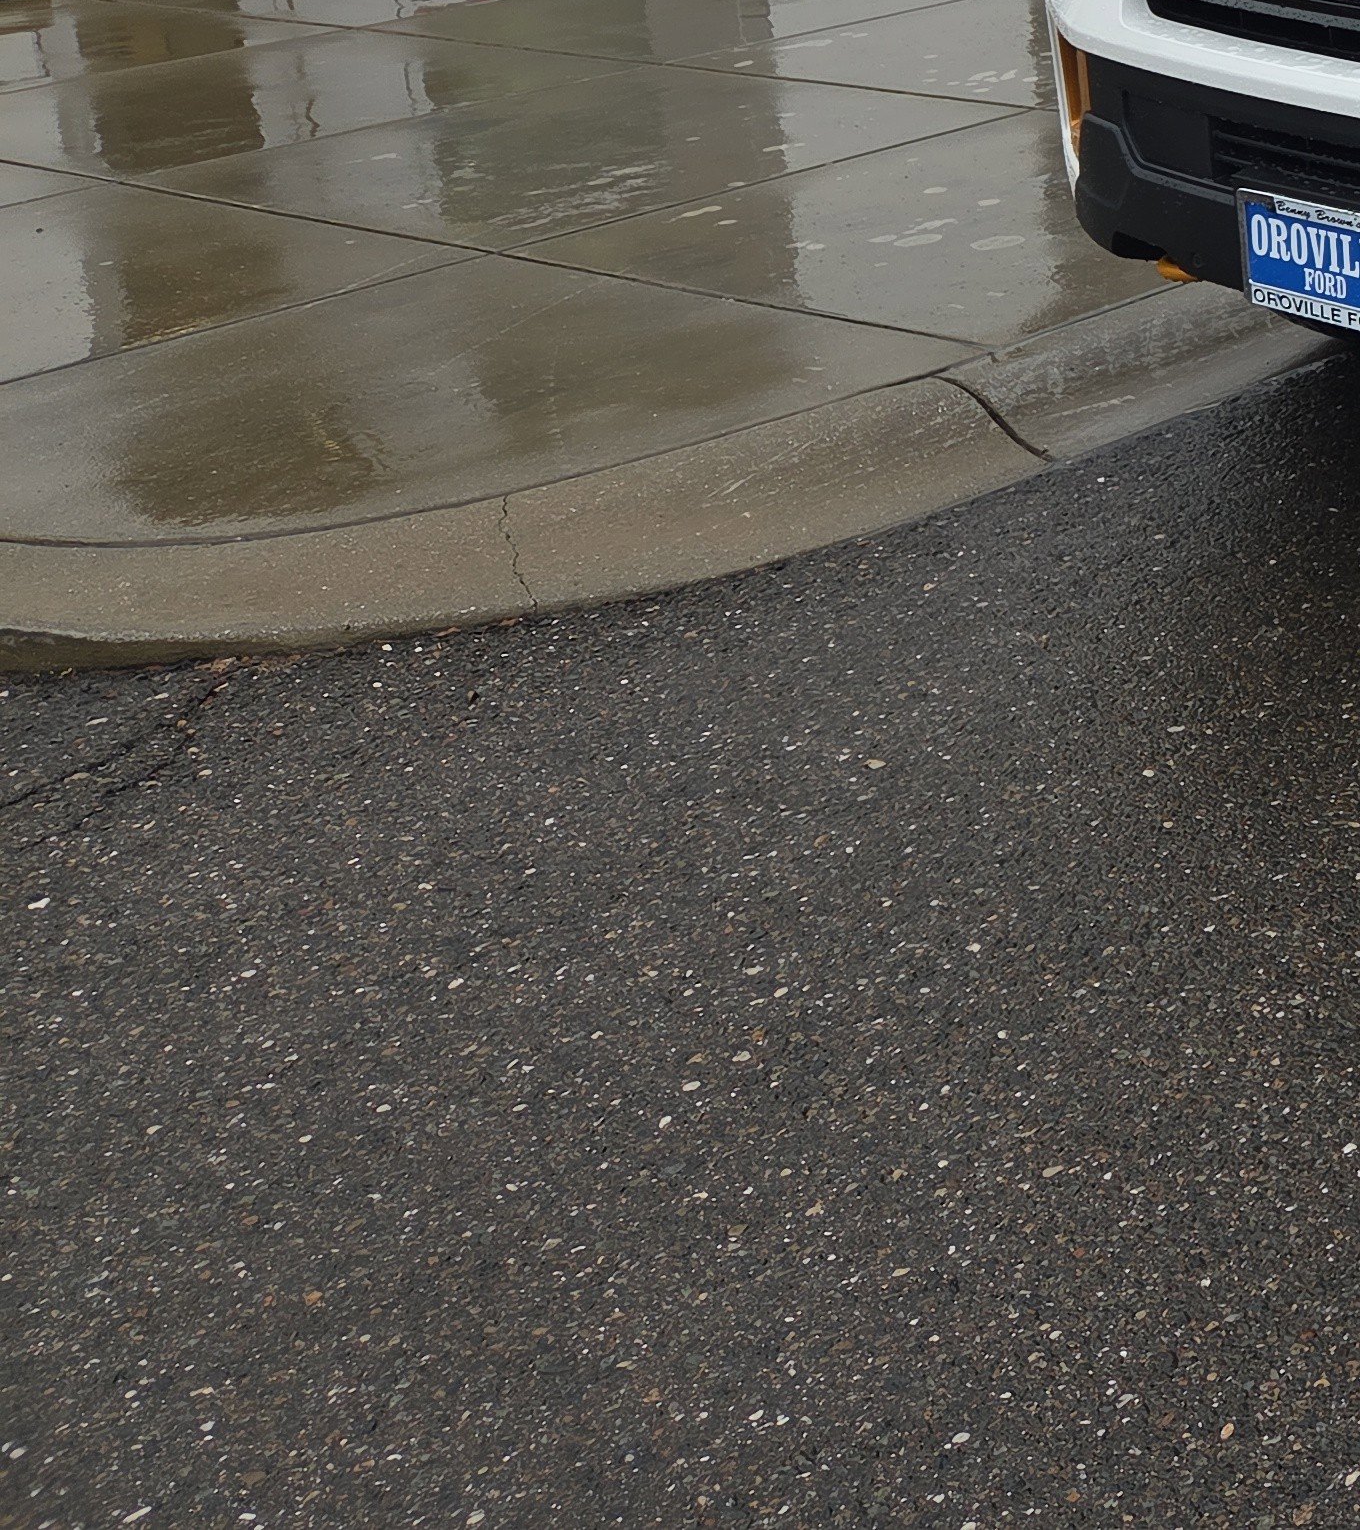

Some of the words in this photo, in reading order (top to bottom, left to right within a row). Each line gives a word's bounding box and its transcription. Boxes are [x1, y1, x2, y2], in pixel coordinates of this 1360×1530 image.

[1275, 200, 1311, 220] Benny
[1304, 268, 1346, 299] FORD
[1253, 289, 1342, 323] OROVILLE
